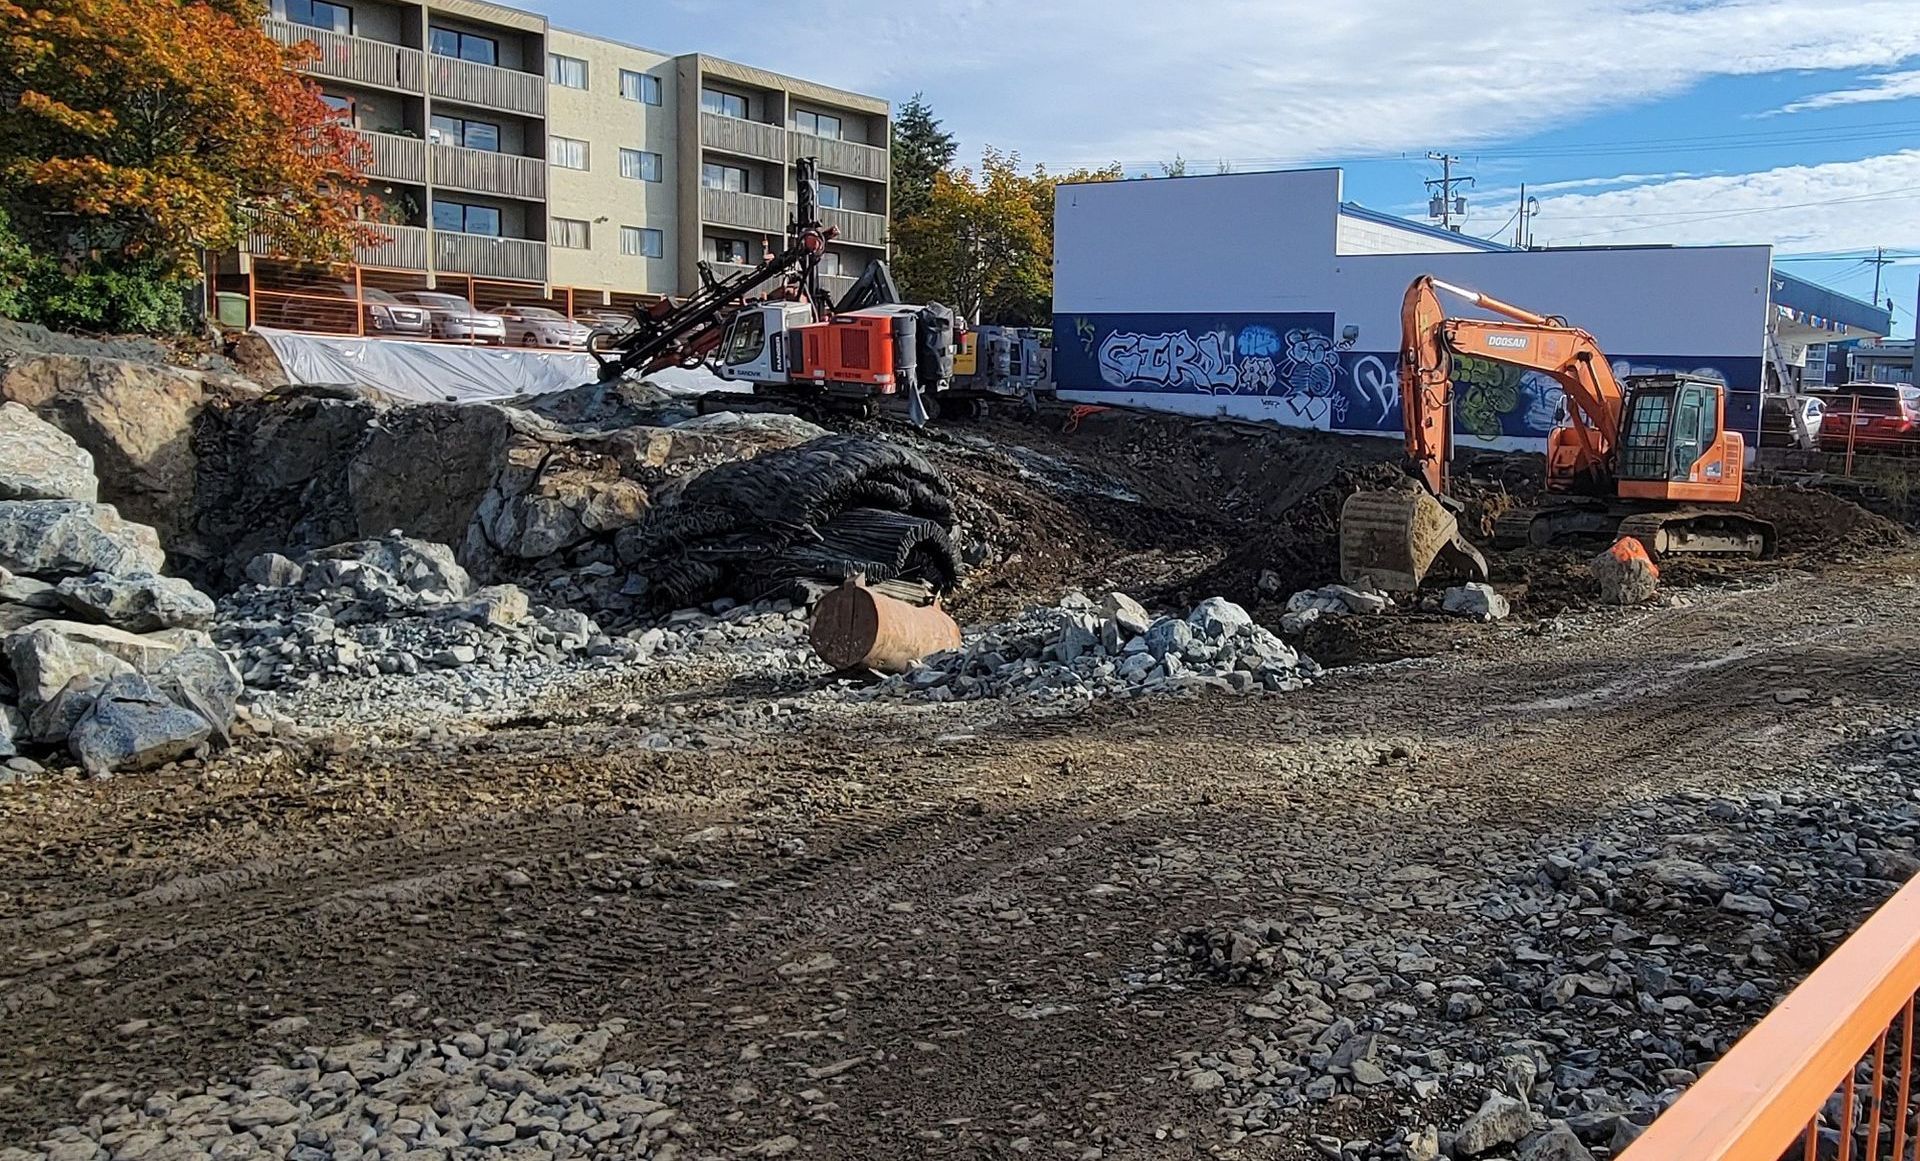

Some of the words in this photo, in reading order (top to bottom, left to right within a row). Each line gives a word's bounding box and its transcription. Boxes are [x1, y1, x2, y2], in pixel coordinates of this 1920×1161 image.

[1488, 336, 1527, 348] DOOSAN
[1098, 329, 1241, 395] GIRL
[737, 369, 762, 377] SANDVIK
